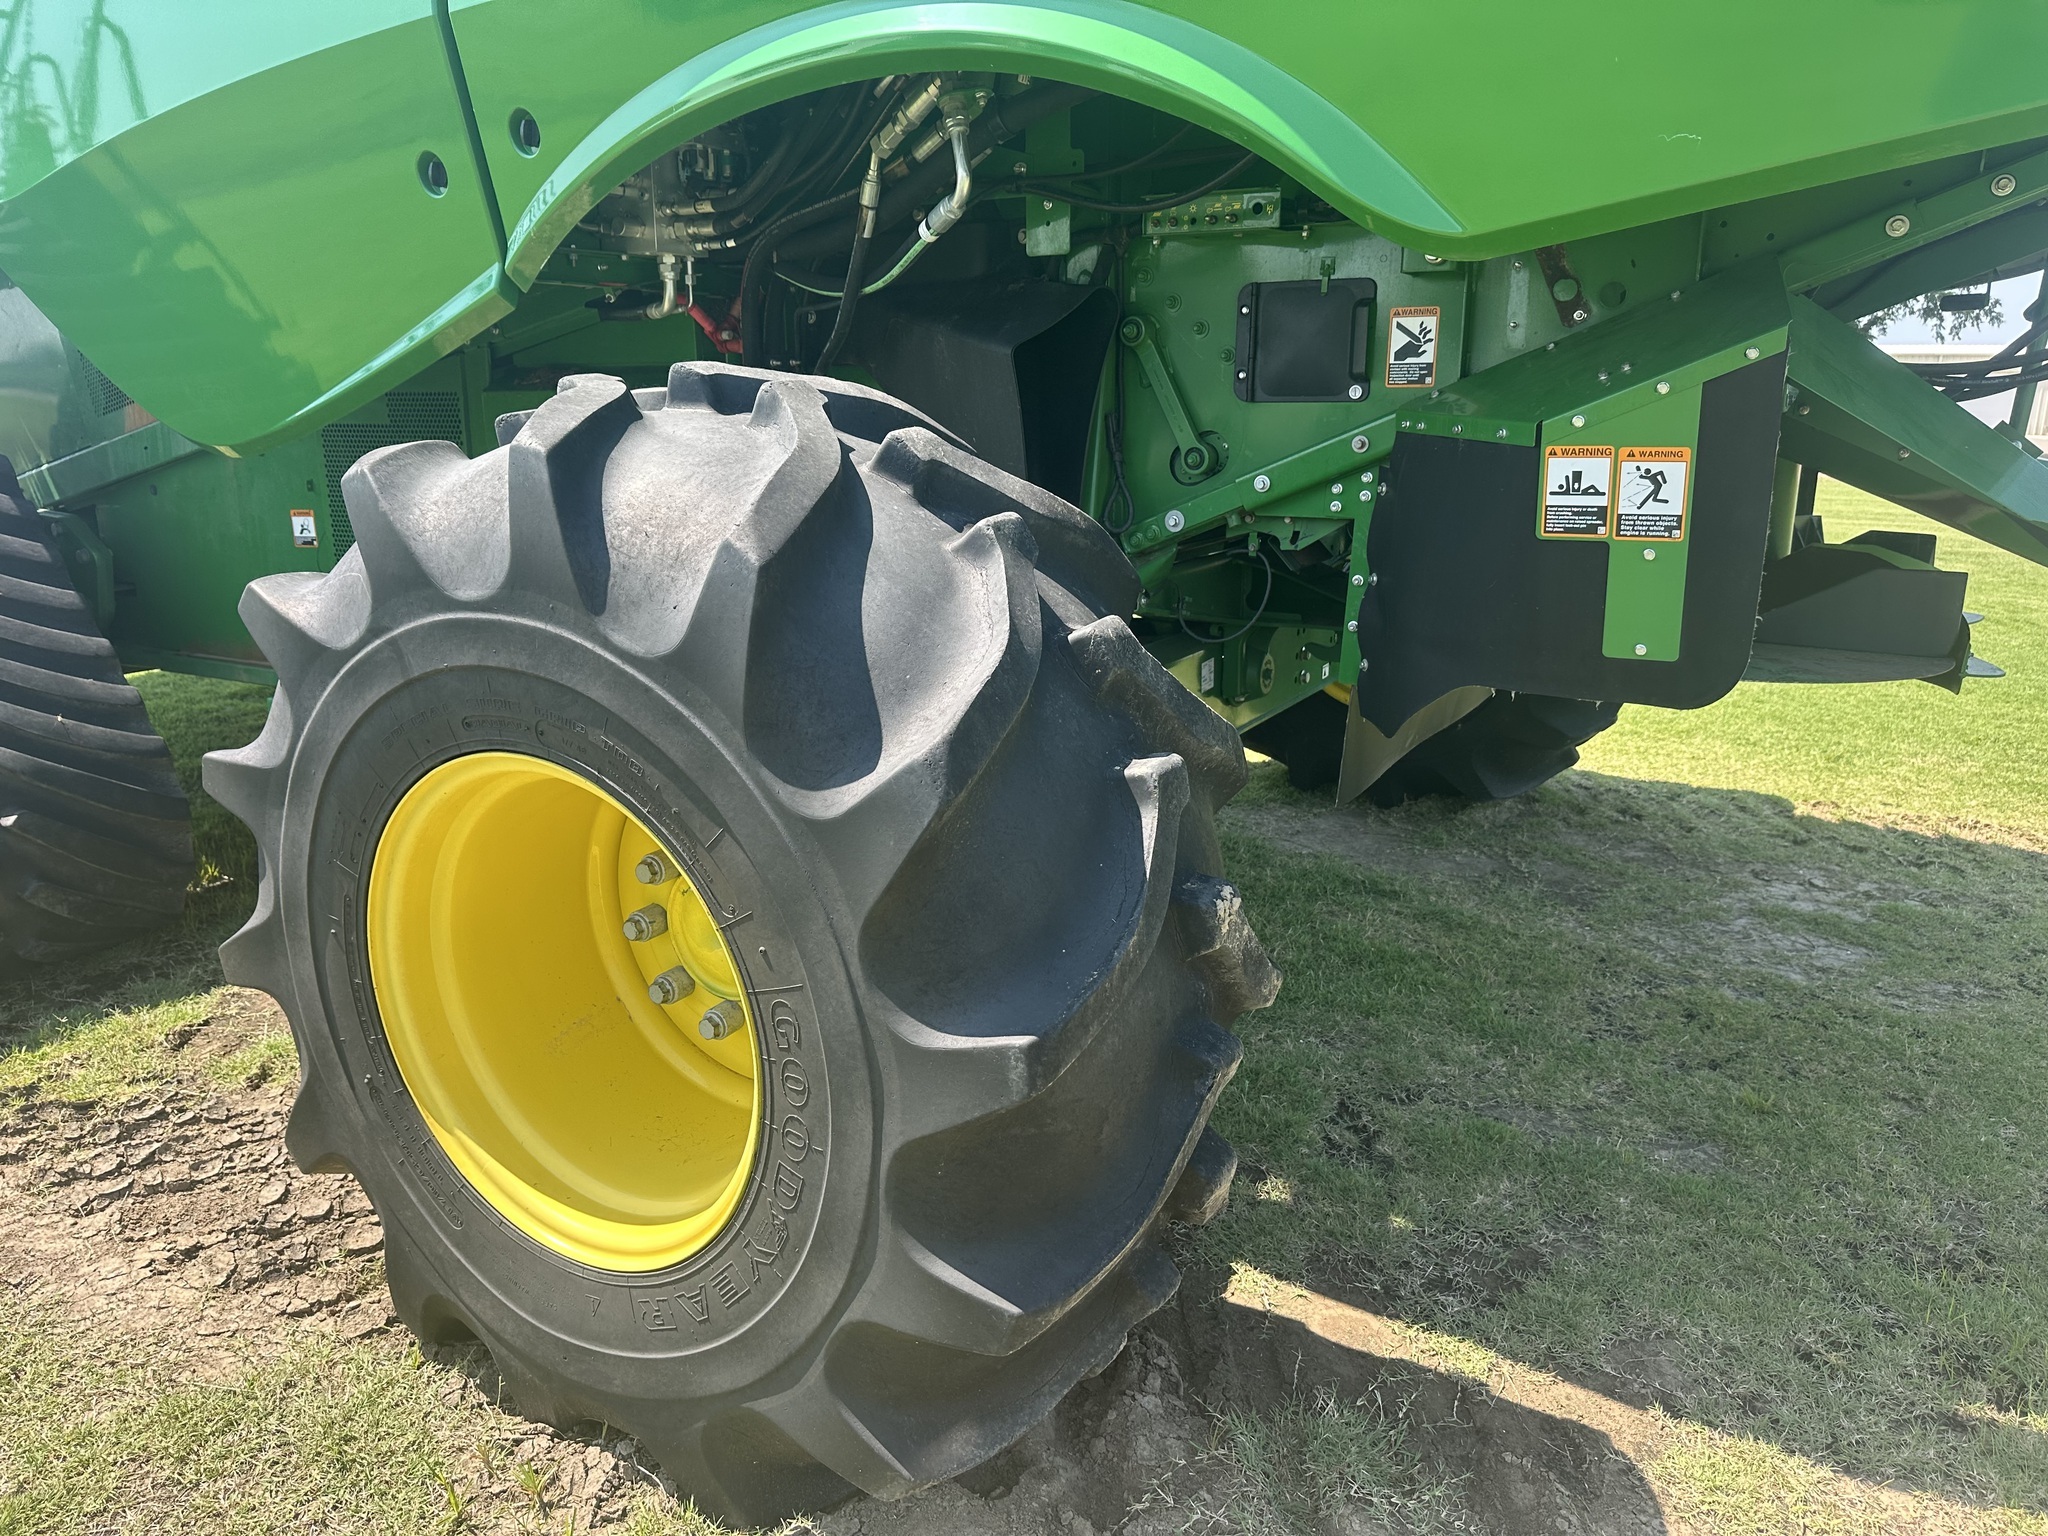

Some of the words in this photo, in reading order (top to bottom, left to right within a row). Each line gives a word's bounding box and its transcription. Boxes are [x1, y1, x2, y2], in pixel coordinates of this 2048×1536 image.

[1400, 307, 1438, 316] WARNING
[1560, 447, 1612, 456] WARNING
[1639, 450, 1684, 458] WARNING
[638, 999, 810, 1331] GOODYEAR
